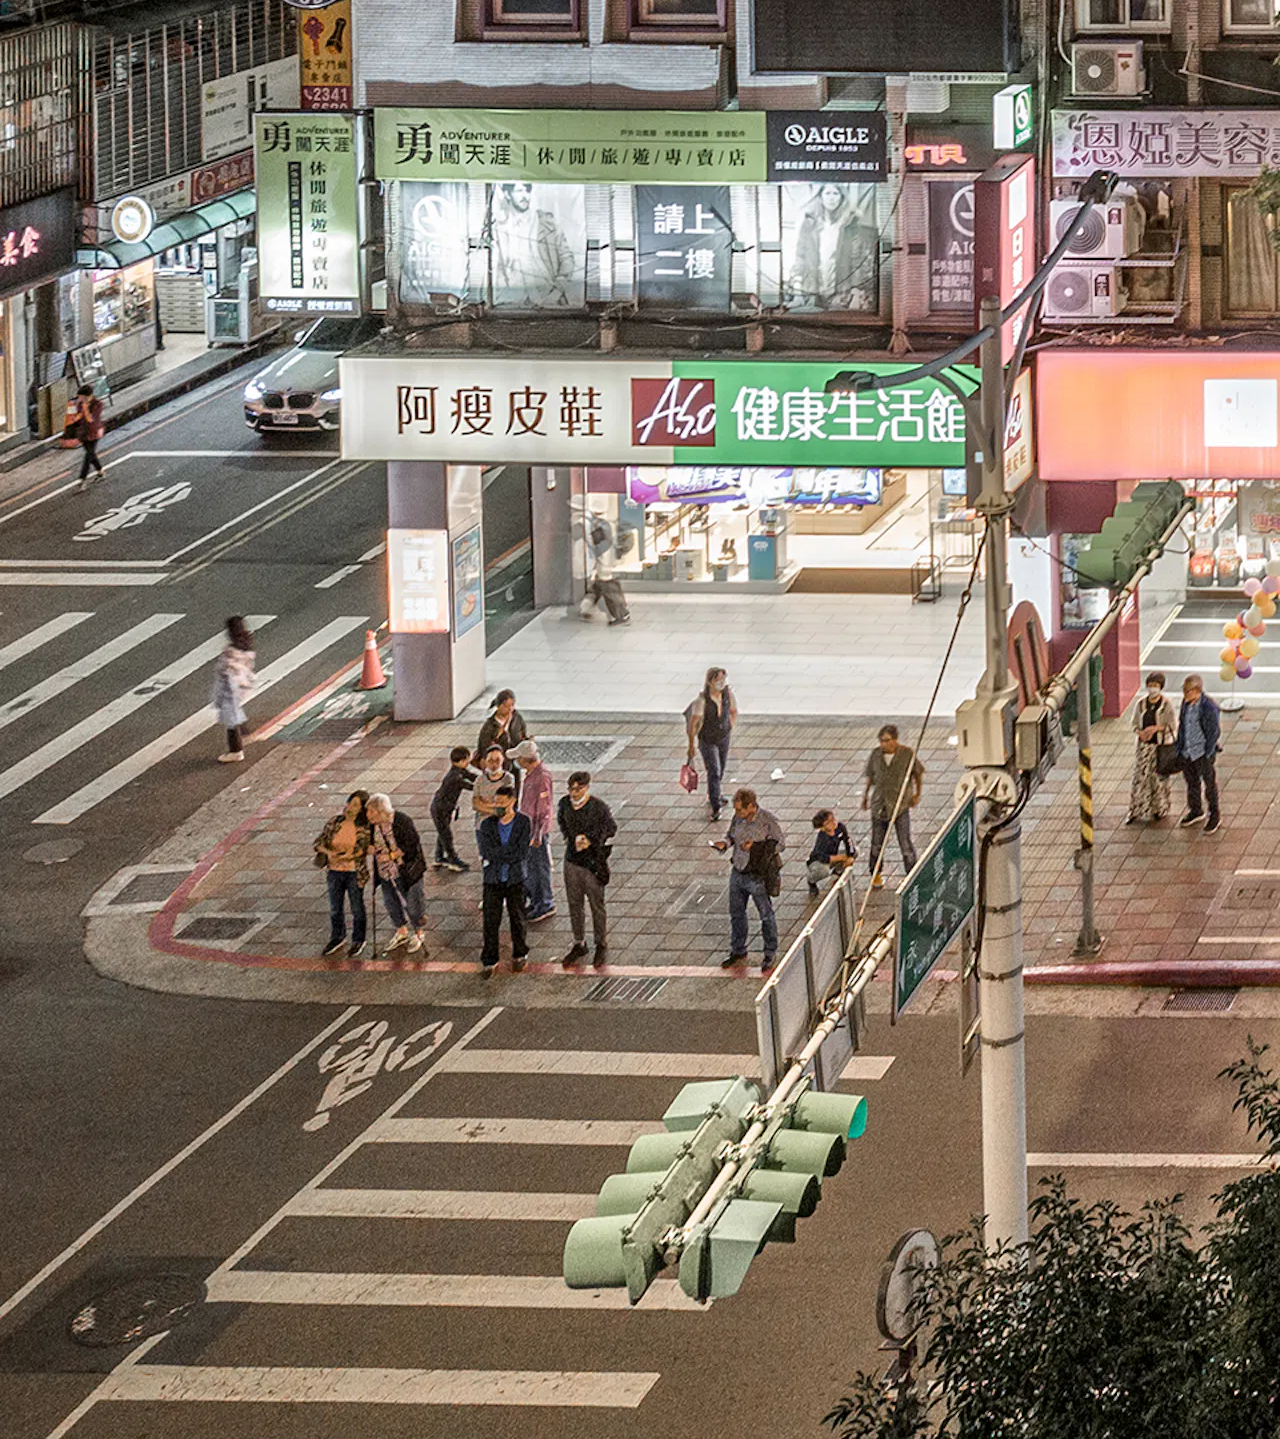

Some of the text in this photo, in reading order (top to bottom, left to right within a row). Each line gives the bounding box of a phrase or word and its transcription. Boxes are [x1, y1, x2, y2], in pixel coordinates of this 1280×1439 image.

[312, 86, 348, 103] 2341
[439, 128, 511, 141] ADVENTURER
[806, 127, 870, 144] AIGLE
[653, 203, 716, 235] 請上
[654, 248, 716, 280] 二樓
[396, 385, 604, 438] 阿瘦皮鞋
[730, 385, 966, 443] 健康生活館
